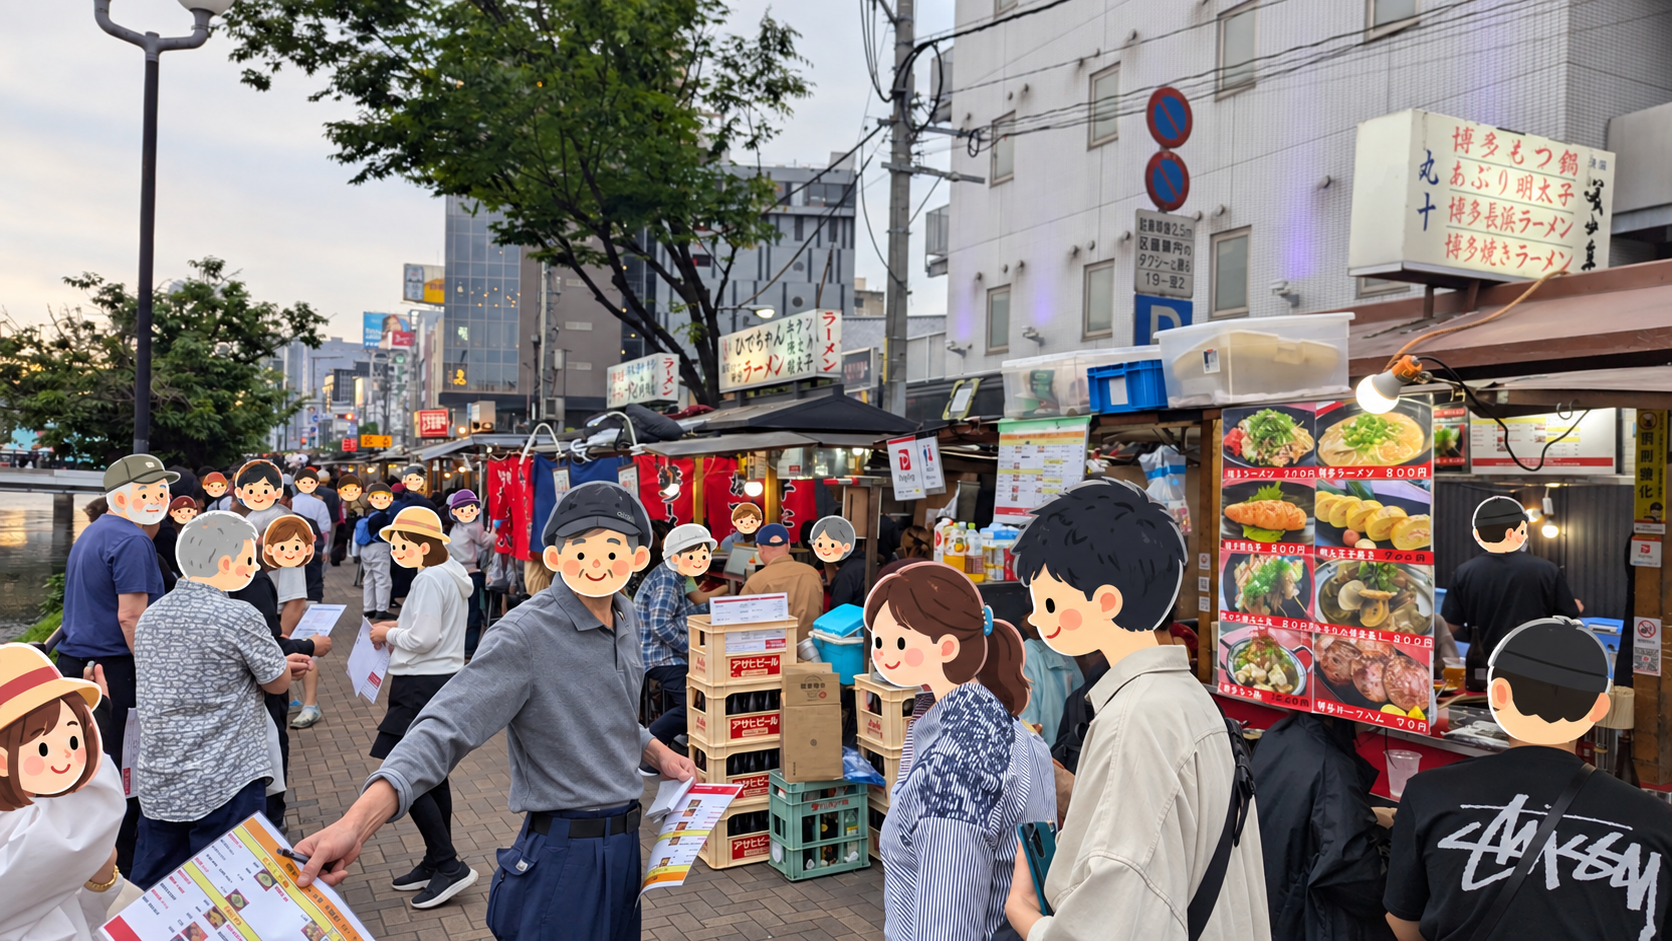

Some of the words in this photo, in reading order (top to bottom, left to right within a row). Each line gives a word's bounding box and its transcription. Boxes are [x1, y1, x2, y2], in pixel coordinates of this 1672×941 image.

[1452, 126, 1579, 177] 博多もつ鍋
[1417, 149, 1439, 231] 丸十
[1449, 160, 1575, 207] あぶり明太子
[1448, 196, 1574, 239] 博多長浜ラーメン
[1444, 233, 1574, 273] 博多焼きラーメン
[822, 311, 837, 372] ラーメン
[662, 357, 675, 396] ラーメン
[743, 354, 784, 383] ラーメン
[1386, 467, 1427, 478] 800円
[732, 657, 779, 670] アサヒビール
[732, 716, 778, 730] アサヒビール
